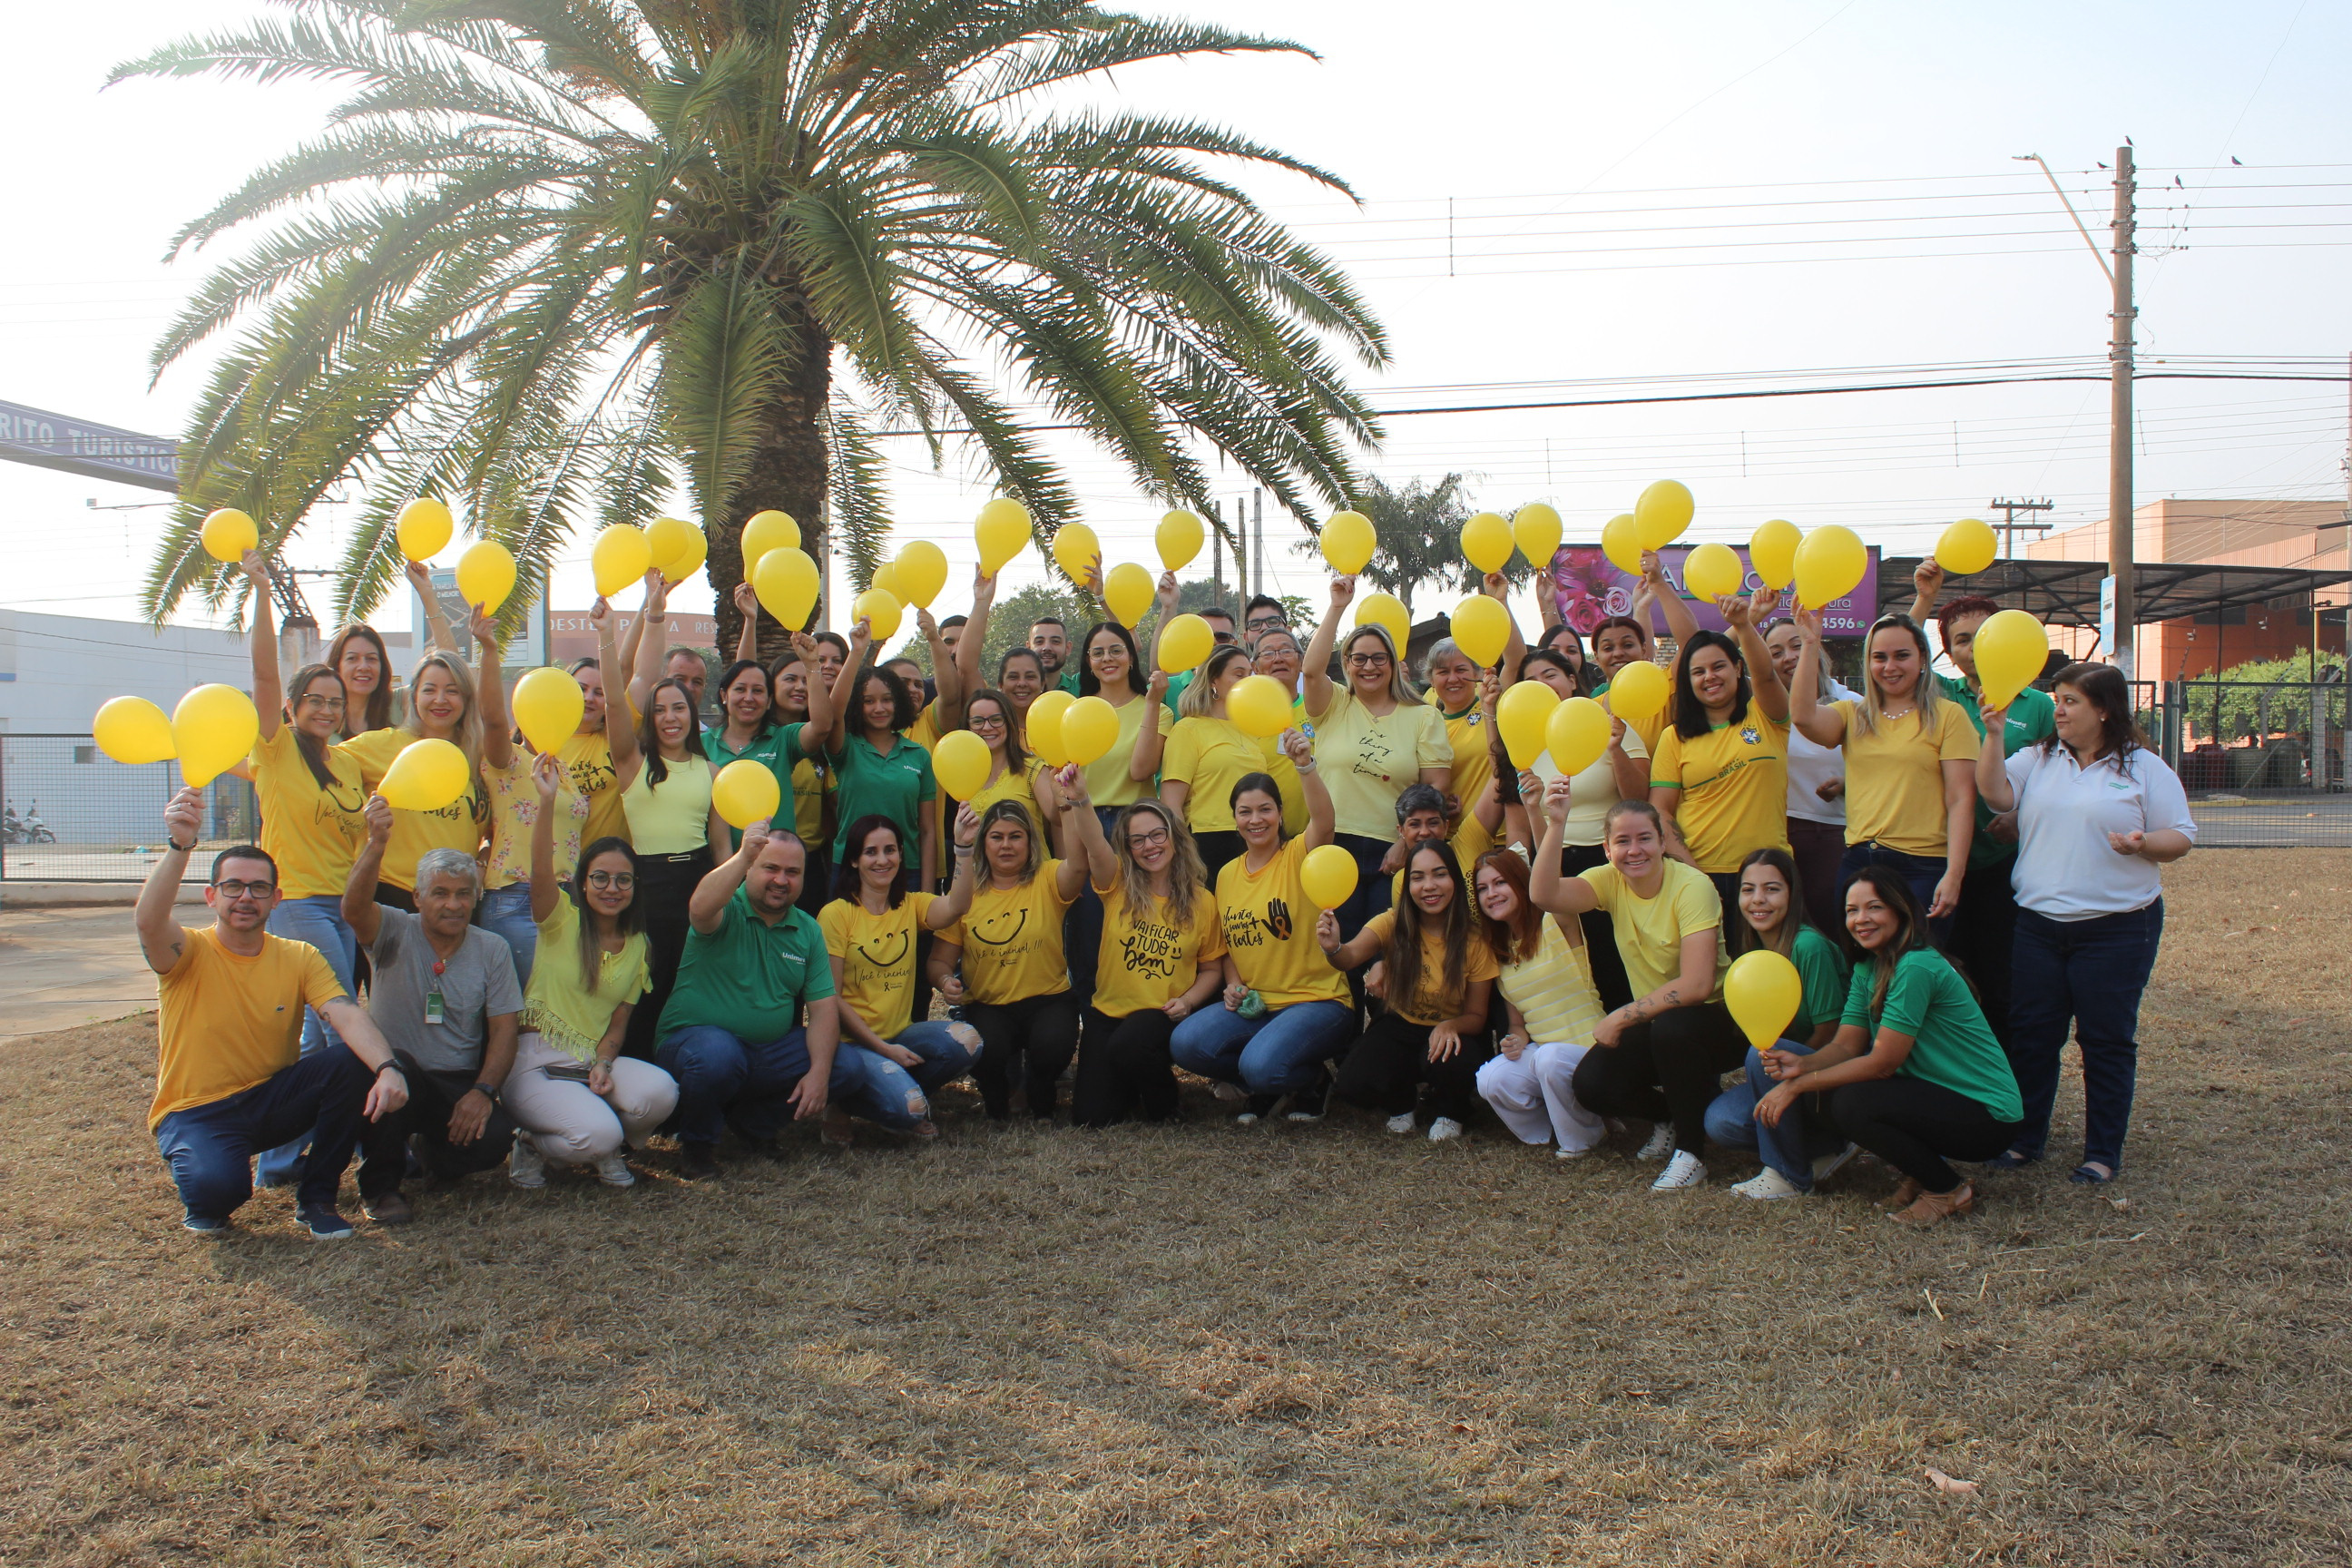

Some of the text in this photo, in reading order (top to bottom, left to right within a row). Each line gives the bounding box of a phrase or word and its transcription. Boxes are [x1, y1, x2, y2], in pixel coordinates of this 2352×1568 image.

[1719, 760, 1747, 779] BRASIL
[1133, 919, 1150, 936] VAI
[1136, 933, 1170, 956] TUDO
